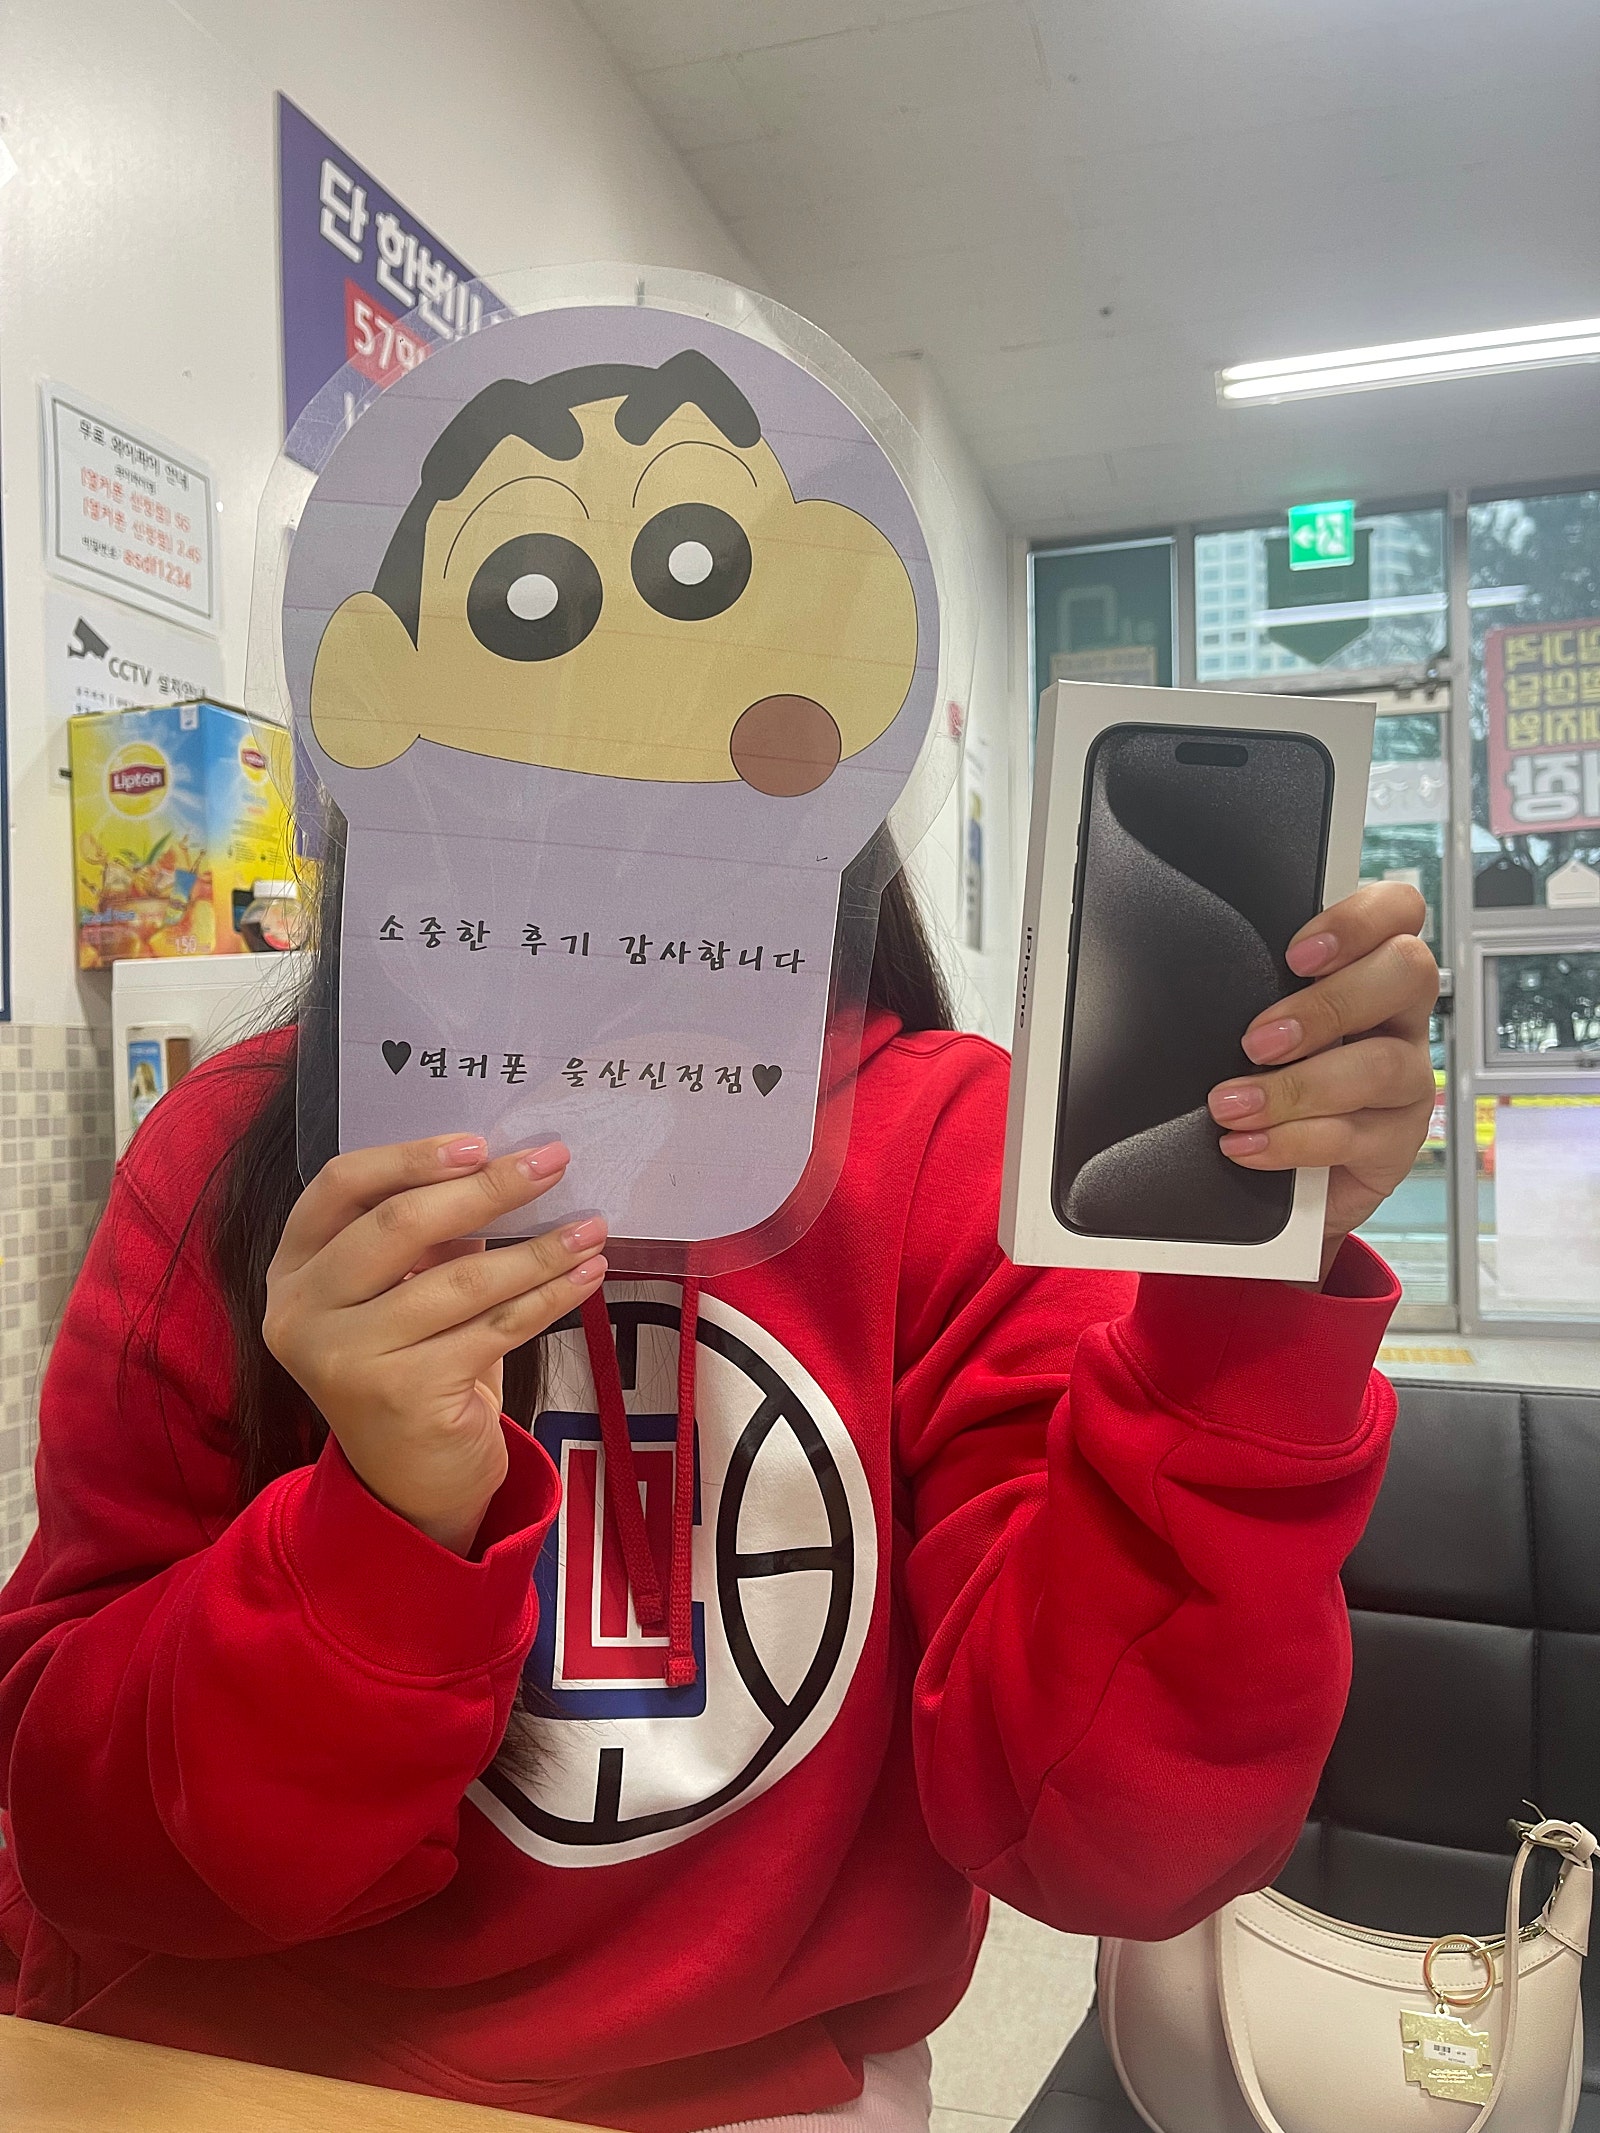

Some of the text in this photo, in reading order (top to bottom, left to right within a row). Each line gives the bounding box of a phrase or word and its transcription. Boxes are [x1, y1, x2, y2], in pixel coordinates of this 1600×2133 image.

[319, 158, 370, 263] 단
[79, 418, 106, 447] 무료
[111, 434, 160, 478] 와이파이
[123, 548, 192, 592] asdf1234
[108, 656, 153, 687] CCTV
[113, 771, 162, 792] Lipton
[379, 914, 806, 974] 소중한 후기 감사합니다
[1019, 926, 1033, 1029] iPhone
[419, 1047, 742, 1094] 옆커폰 울산신정점
